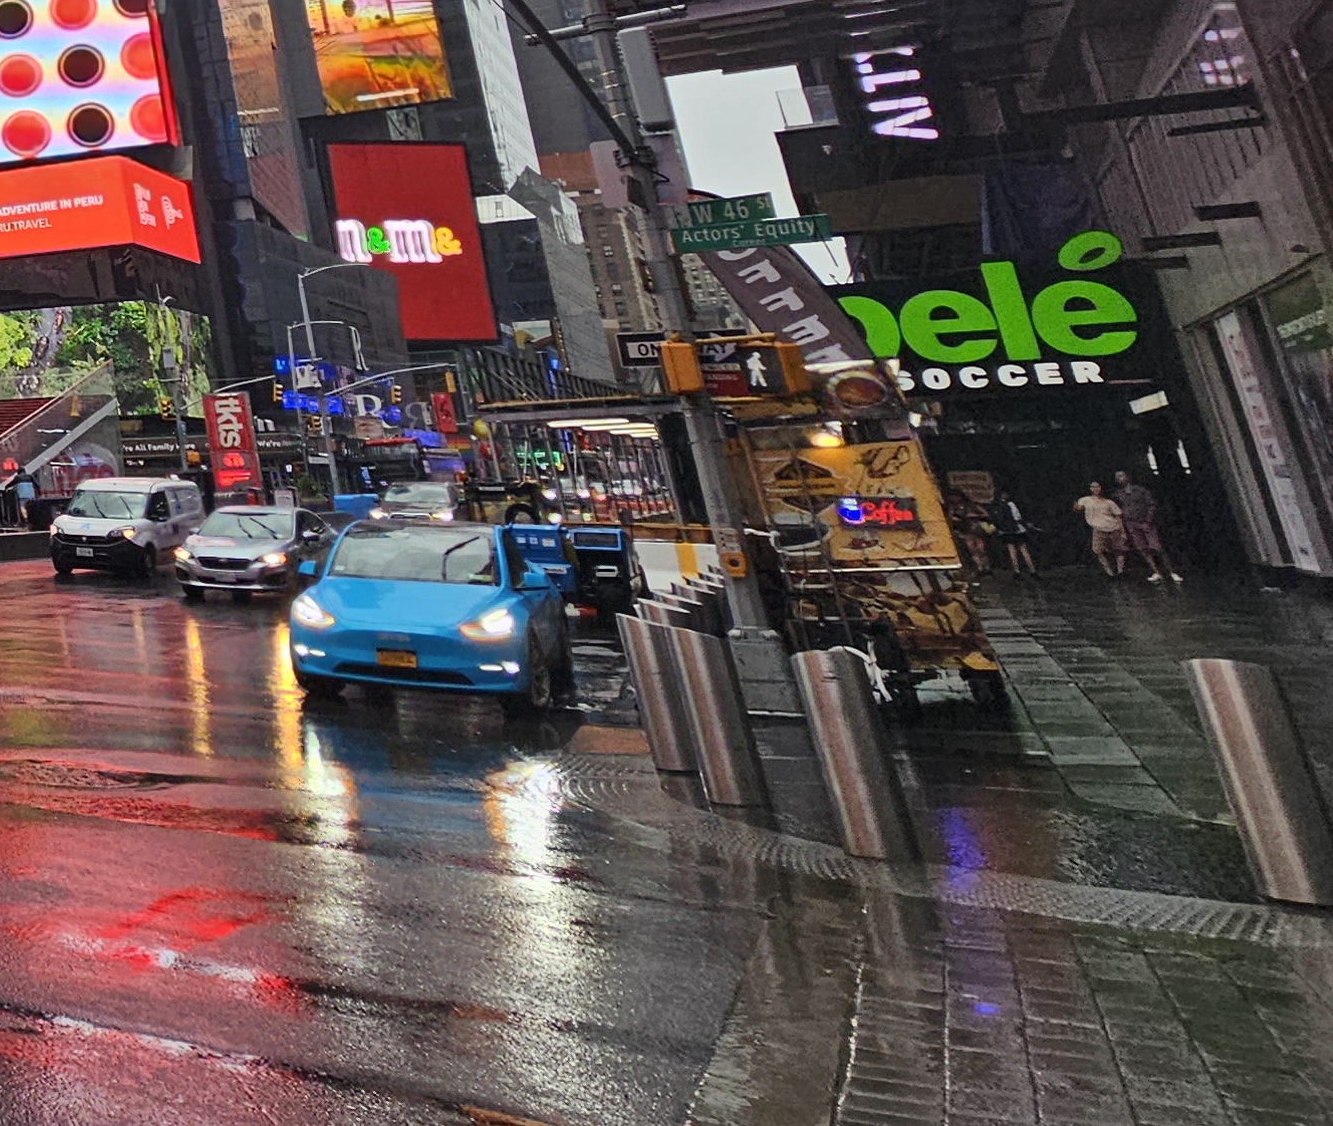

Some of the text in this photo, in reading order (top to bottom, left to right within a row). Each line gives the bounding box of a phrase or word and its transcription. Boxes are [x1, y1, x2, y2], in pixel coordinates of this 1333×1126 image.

[60, 199, 72, 210] IN
[73, 194, 104, 208] PERU
[694, 195, 770, 225] W 46 St
[681, 217, 816, 246] Actors' Equity
[731, 236, 766, 247] Corner
[898, 360, 1105, 391] SOCCER
[213, 396, 245, 450] tkts
[135, 442, 147, 452] All
[148, 441, 175, 453] Family
